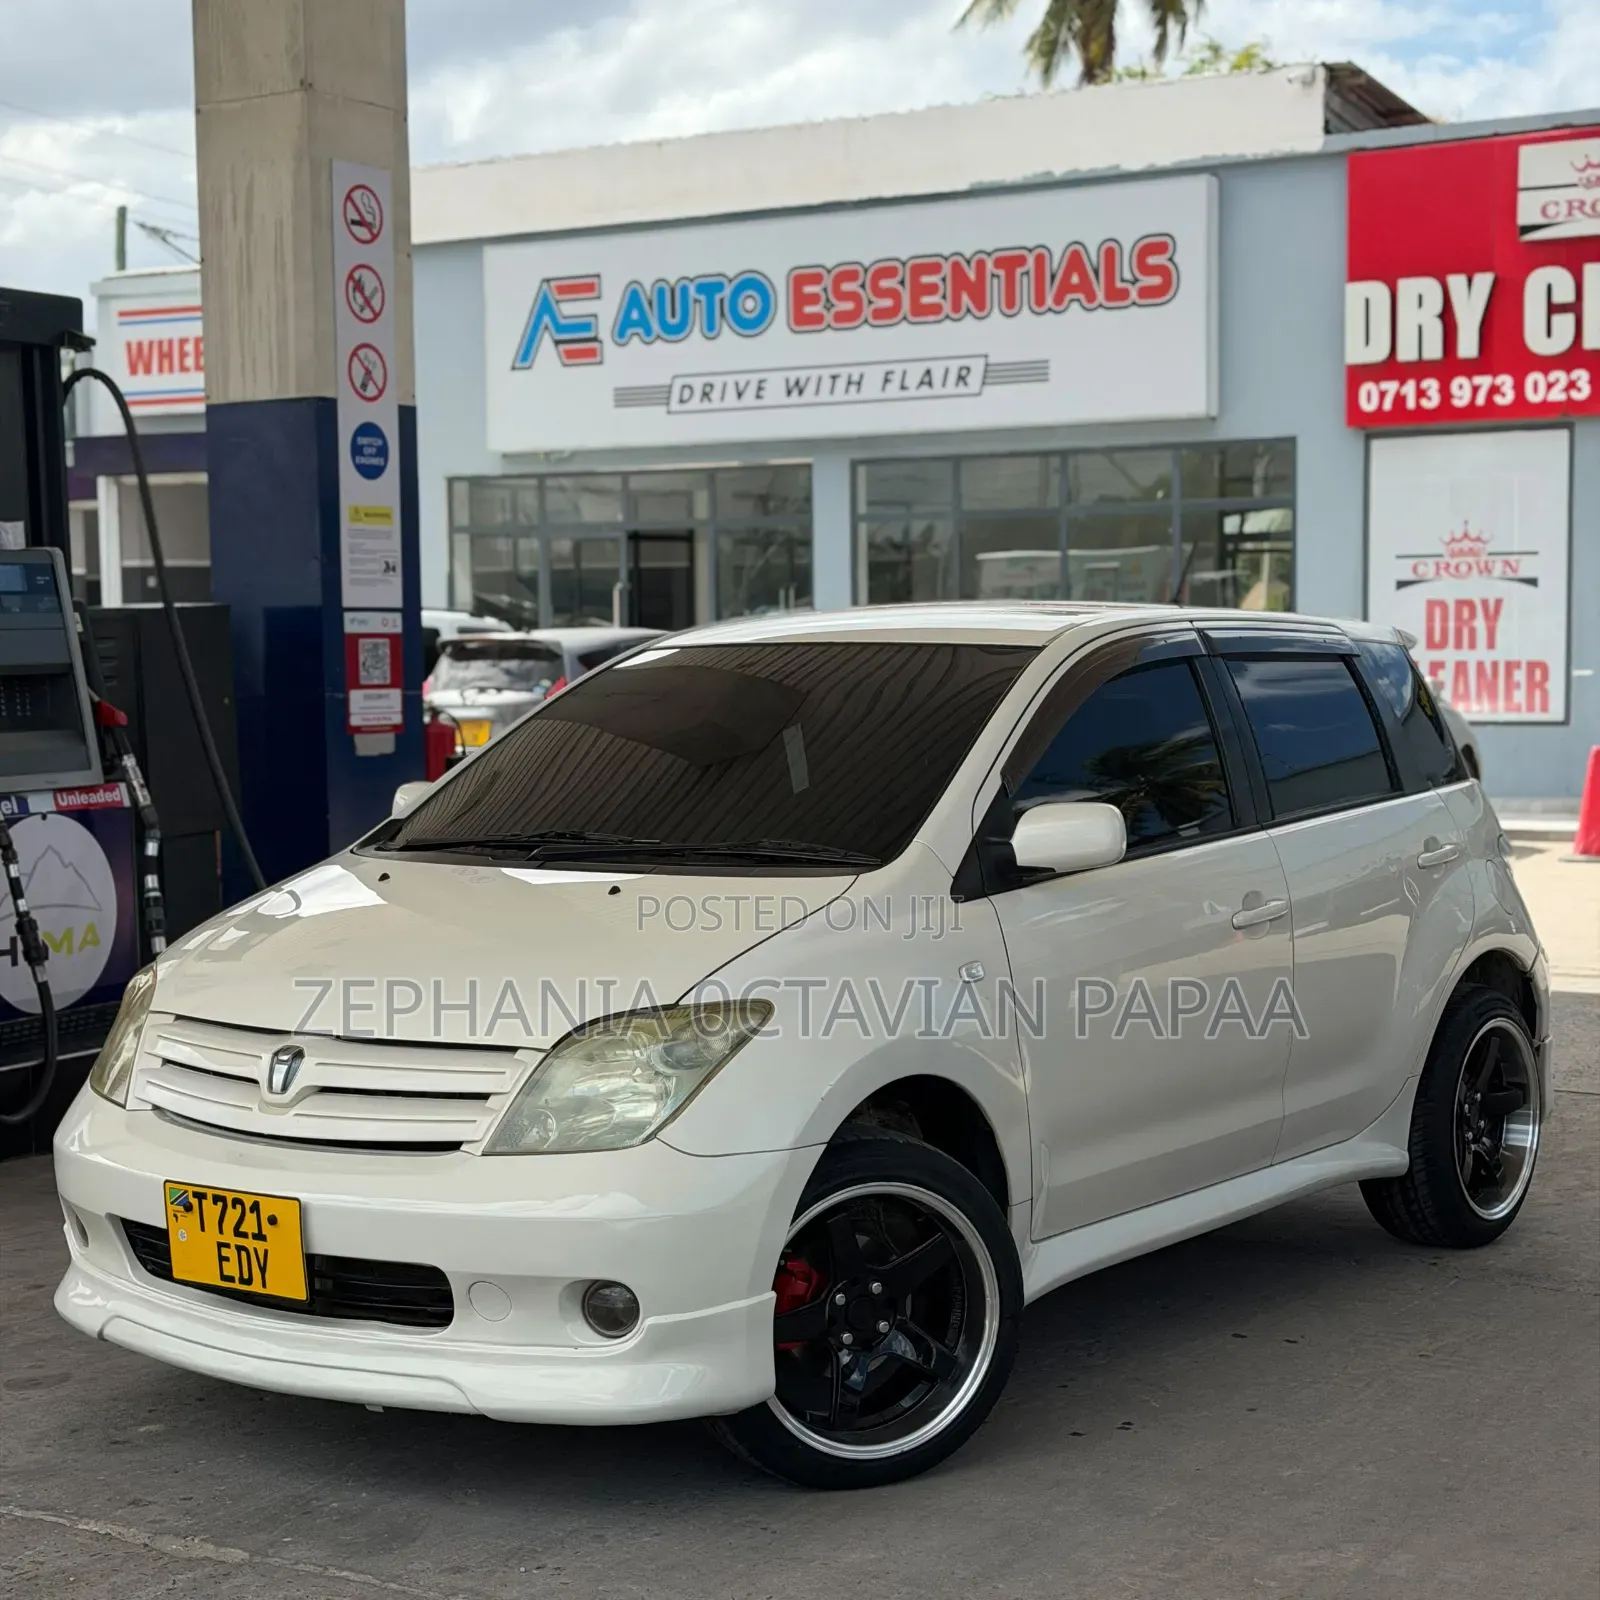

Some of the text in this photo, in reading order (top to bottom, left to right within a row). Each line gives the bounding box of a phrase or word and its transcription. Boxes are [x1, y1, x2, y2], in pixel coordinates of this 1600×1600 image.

[612, 269, 777, 347] AUTO
[786, 232, 1180, 334] ESSENTIALS
[1345, 271, 1497, 366] DRY
[678, 365, 972, 405] DRIVE WITH FLAIR
[1358, 368, 1592, 413] 0713 973 023
[1411, 559, 1521, 580] CROWN
[1425, 598, 1504, 651] DRY
[1414, 659, 1551, 714] EANER
[56, 787, 121, 806] Unleaded
[216, 1240, 269, 1290] EDY
